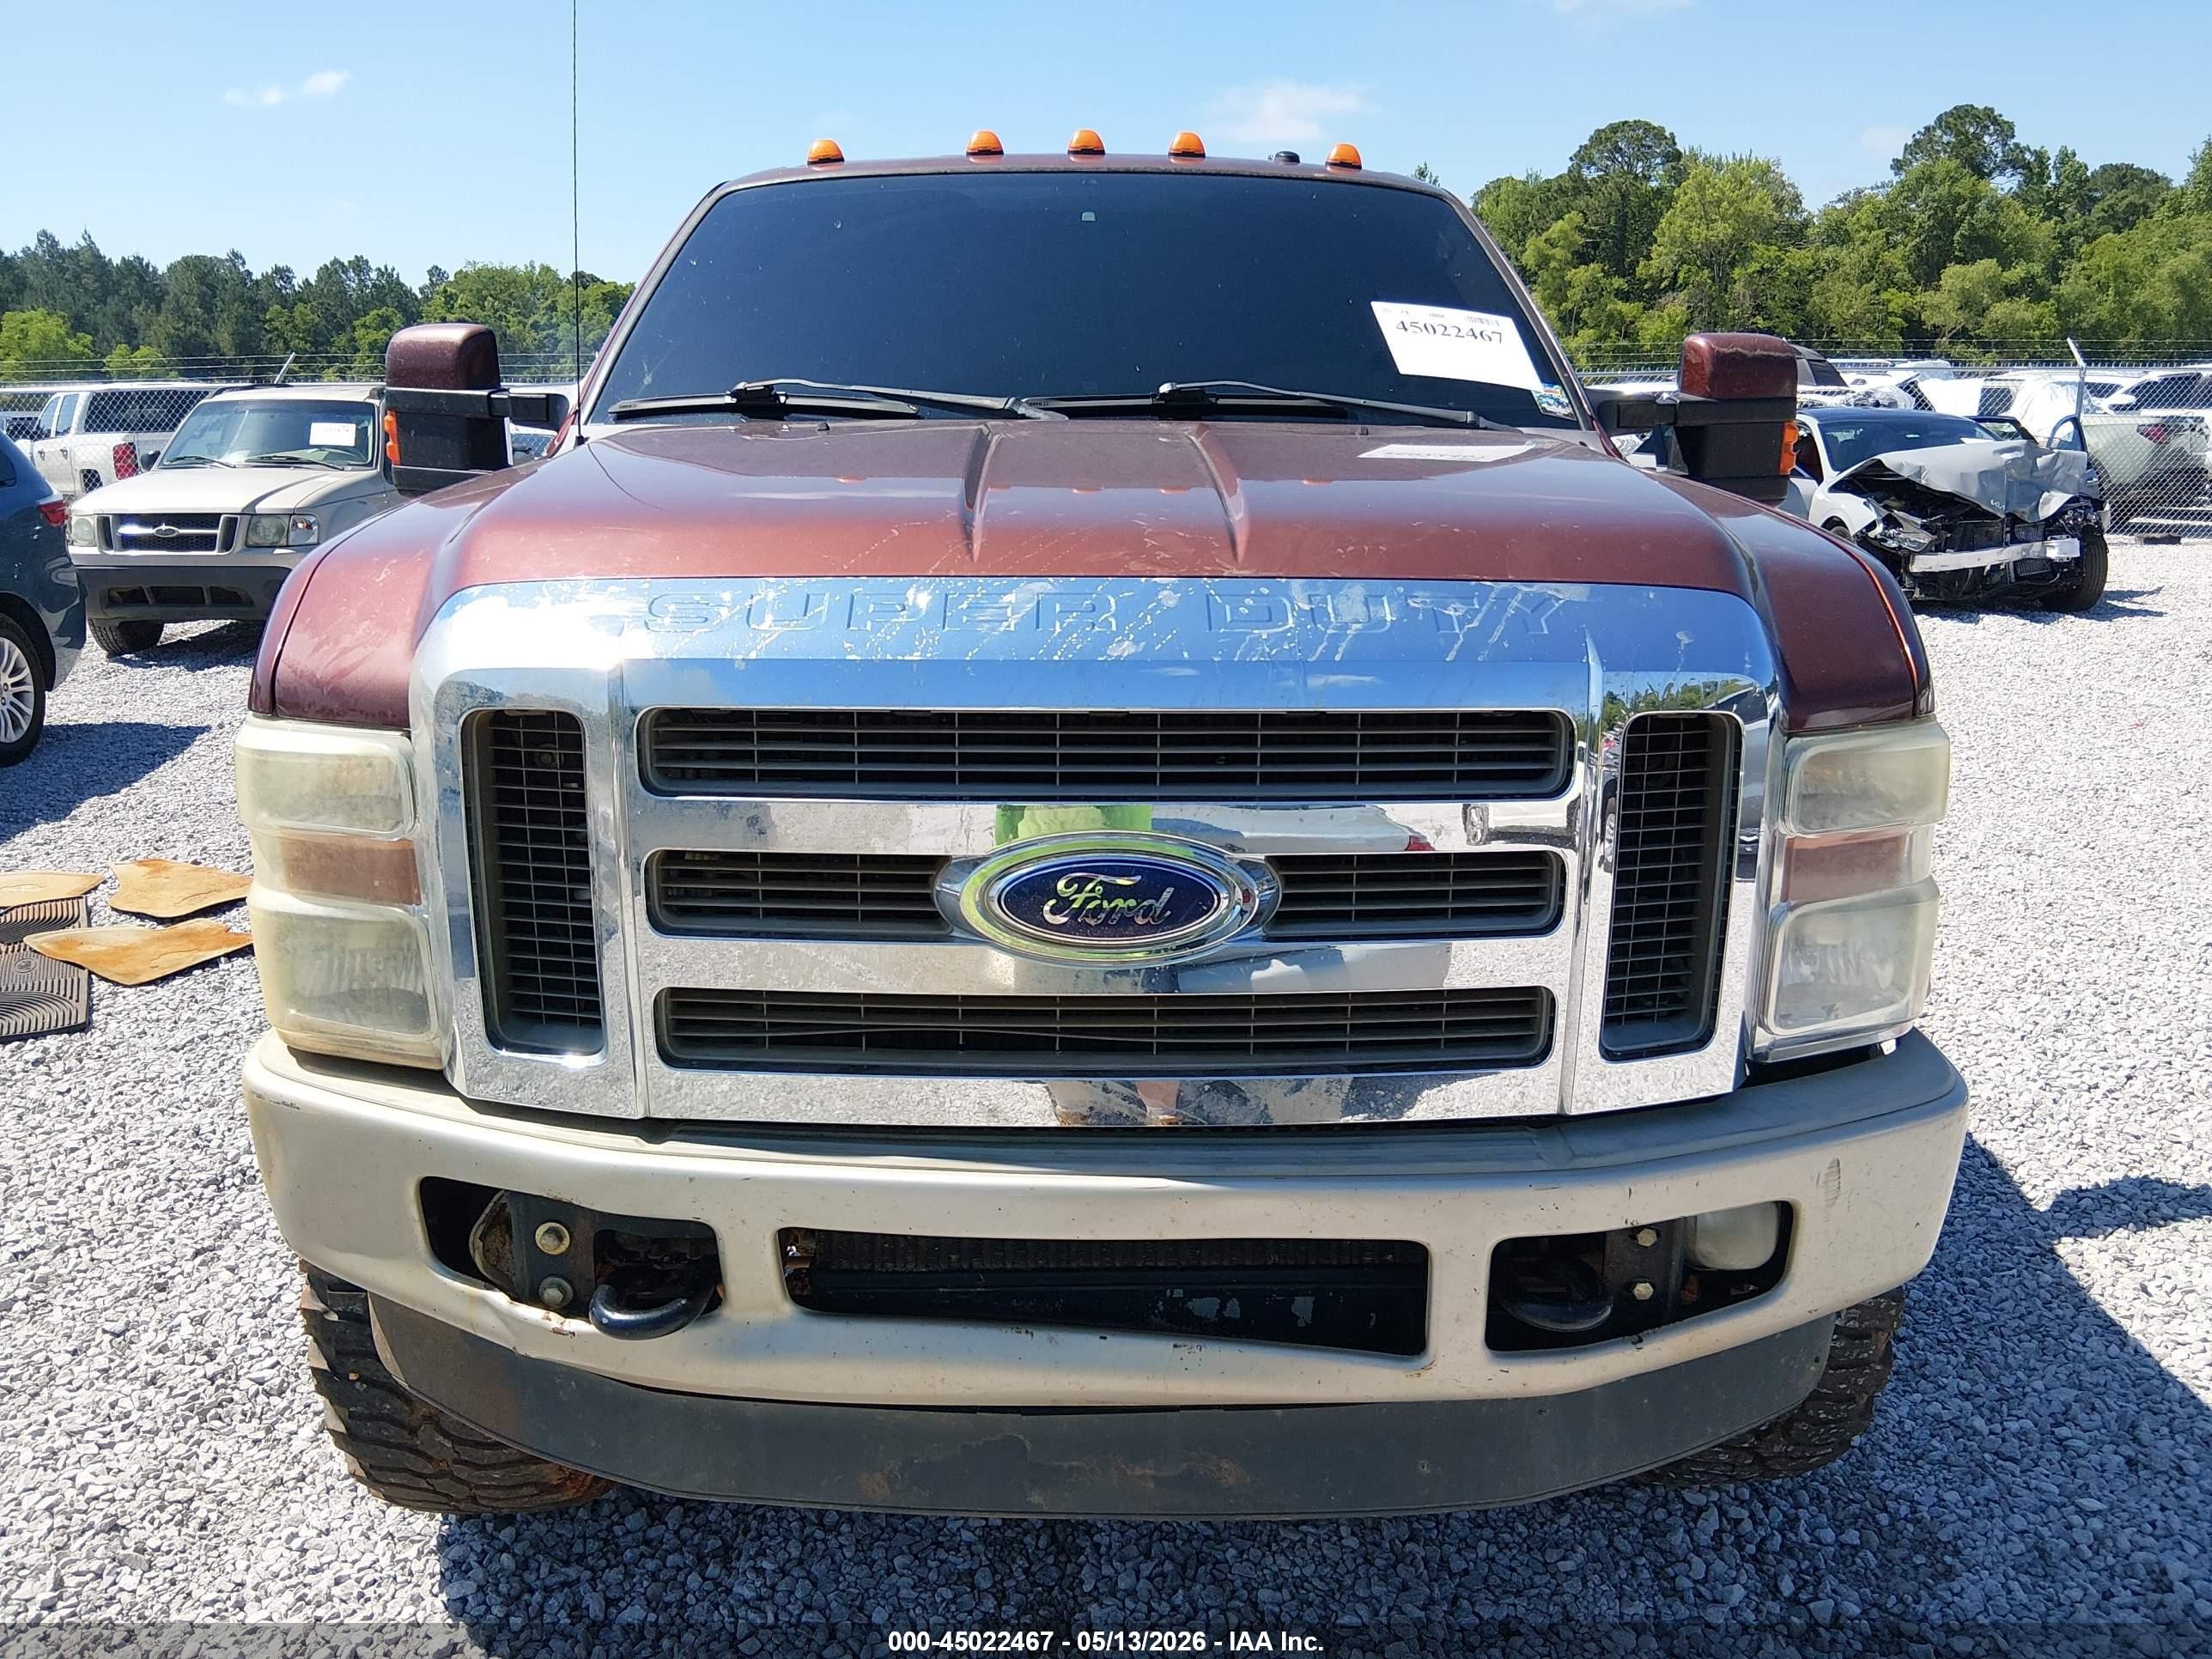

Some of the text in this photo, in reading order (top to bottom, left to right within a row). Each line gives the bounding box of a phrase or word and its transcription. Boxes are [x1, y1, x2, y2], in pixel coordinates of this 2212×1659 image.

[1395, 320, 1503, 343] 45022467
[643, 592, 1567, 634] SUPER DUTY
[1042, 872, 1176, 926] Ford
